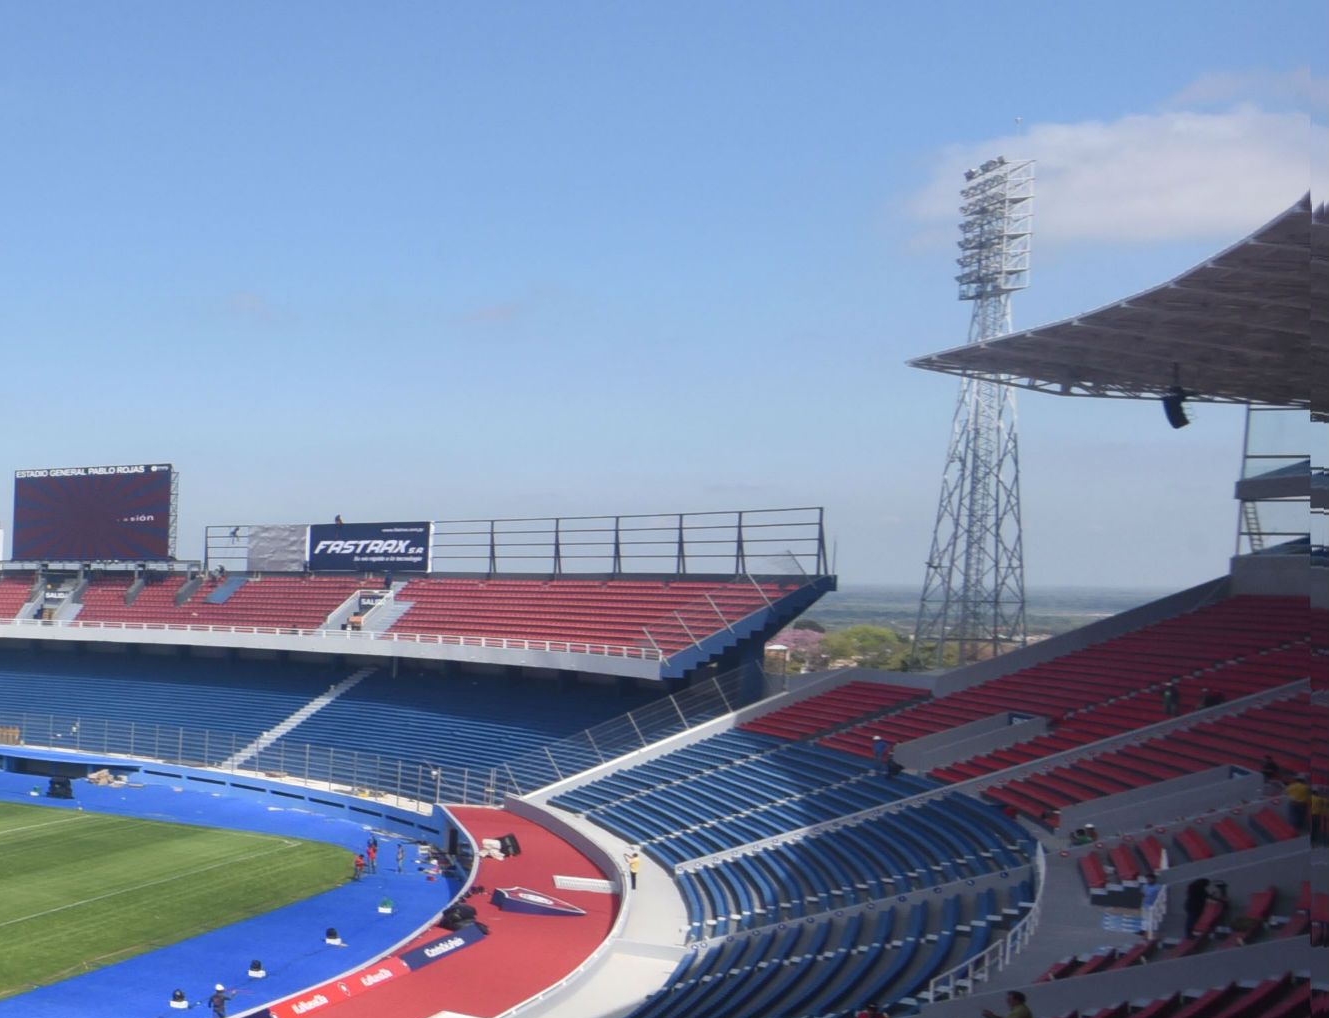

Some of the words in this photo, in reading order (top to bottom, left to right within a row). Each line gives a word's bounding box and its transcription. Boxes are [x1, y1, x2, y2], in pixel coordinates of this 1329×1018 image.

[16, 470, 48, 478] ESTADIO
[50, 468, 86, 476] GENERAL
[88, 466, 115, 475] PABLO
[116, 465, 145, 473] ROJAS
[314, 540, 411, 554] FASTRAX
